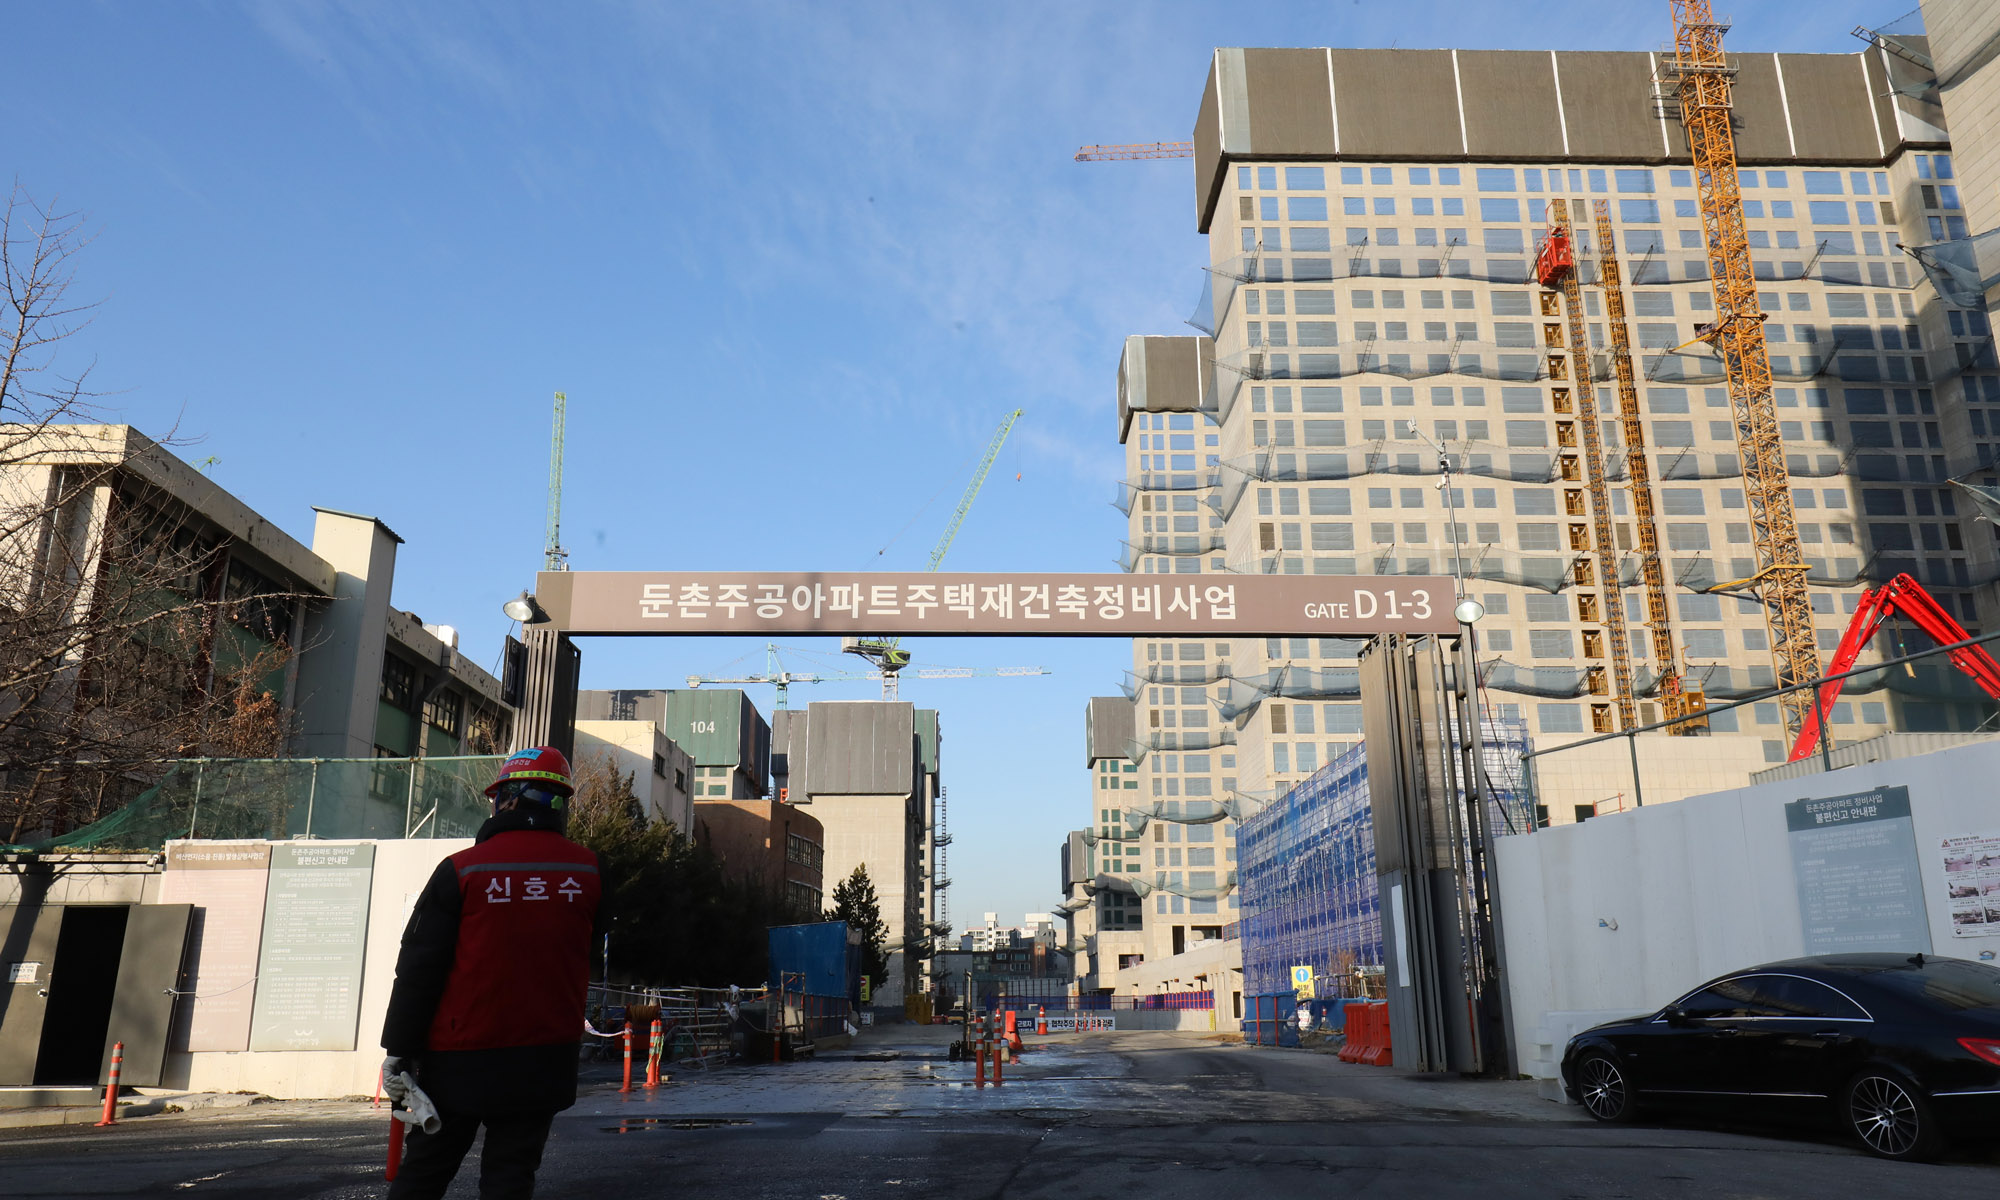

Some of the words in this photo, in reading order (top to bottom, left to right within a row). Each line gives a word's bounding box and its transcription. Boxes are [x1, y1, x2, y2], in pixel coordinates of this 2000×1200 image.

[638, 583, 1237, 620] 둔촌주공아파트주택재건축정비사업
[1304, 602, 1350, 619] GATE
[690, 720, 716, 734] 104
[1805, 800, 1853, 813] 둔촌주공아파트
[1854, 794, 1883, 806] 정비사업
[1815, 810, 1849, 824] 불편신고
[1850, 805, 1877, 819] 안내판
[291, 848, 331, 856] 둔촌주공아파트
[332, 848, 356, 856] 정비사업
[297, 856, 325, 866] 불편신고
[327, 855, 349, 865] 안내판
[484, 876, 583, 904] 신호수
